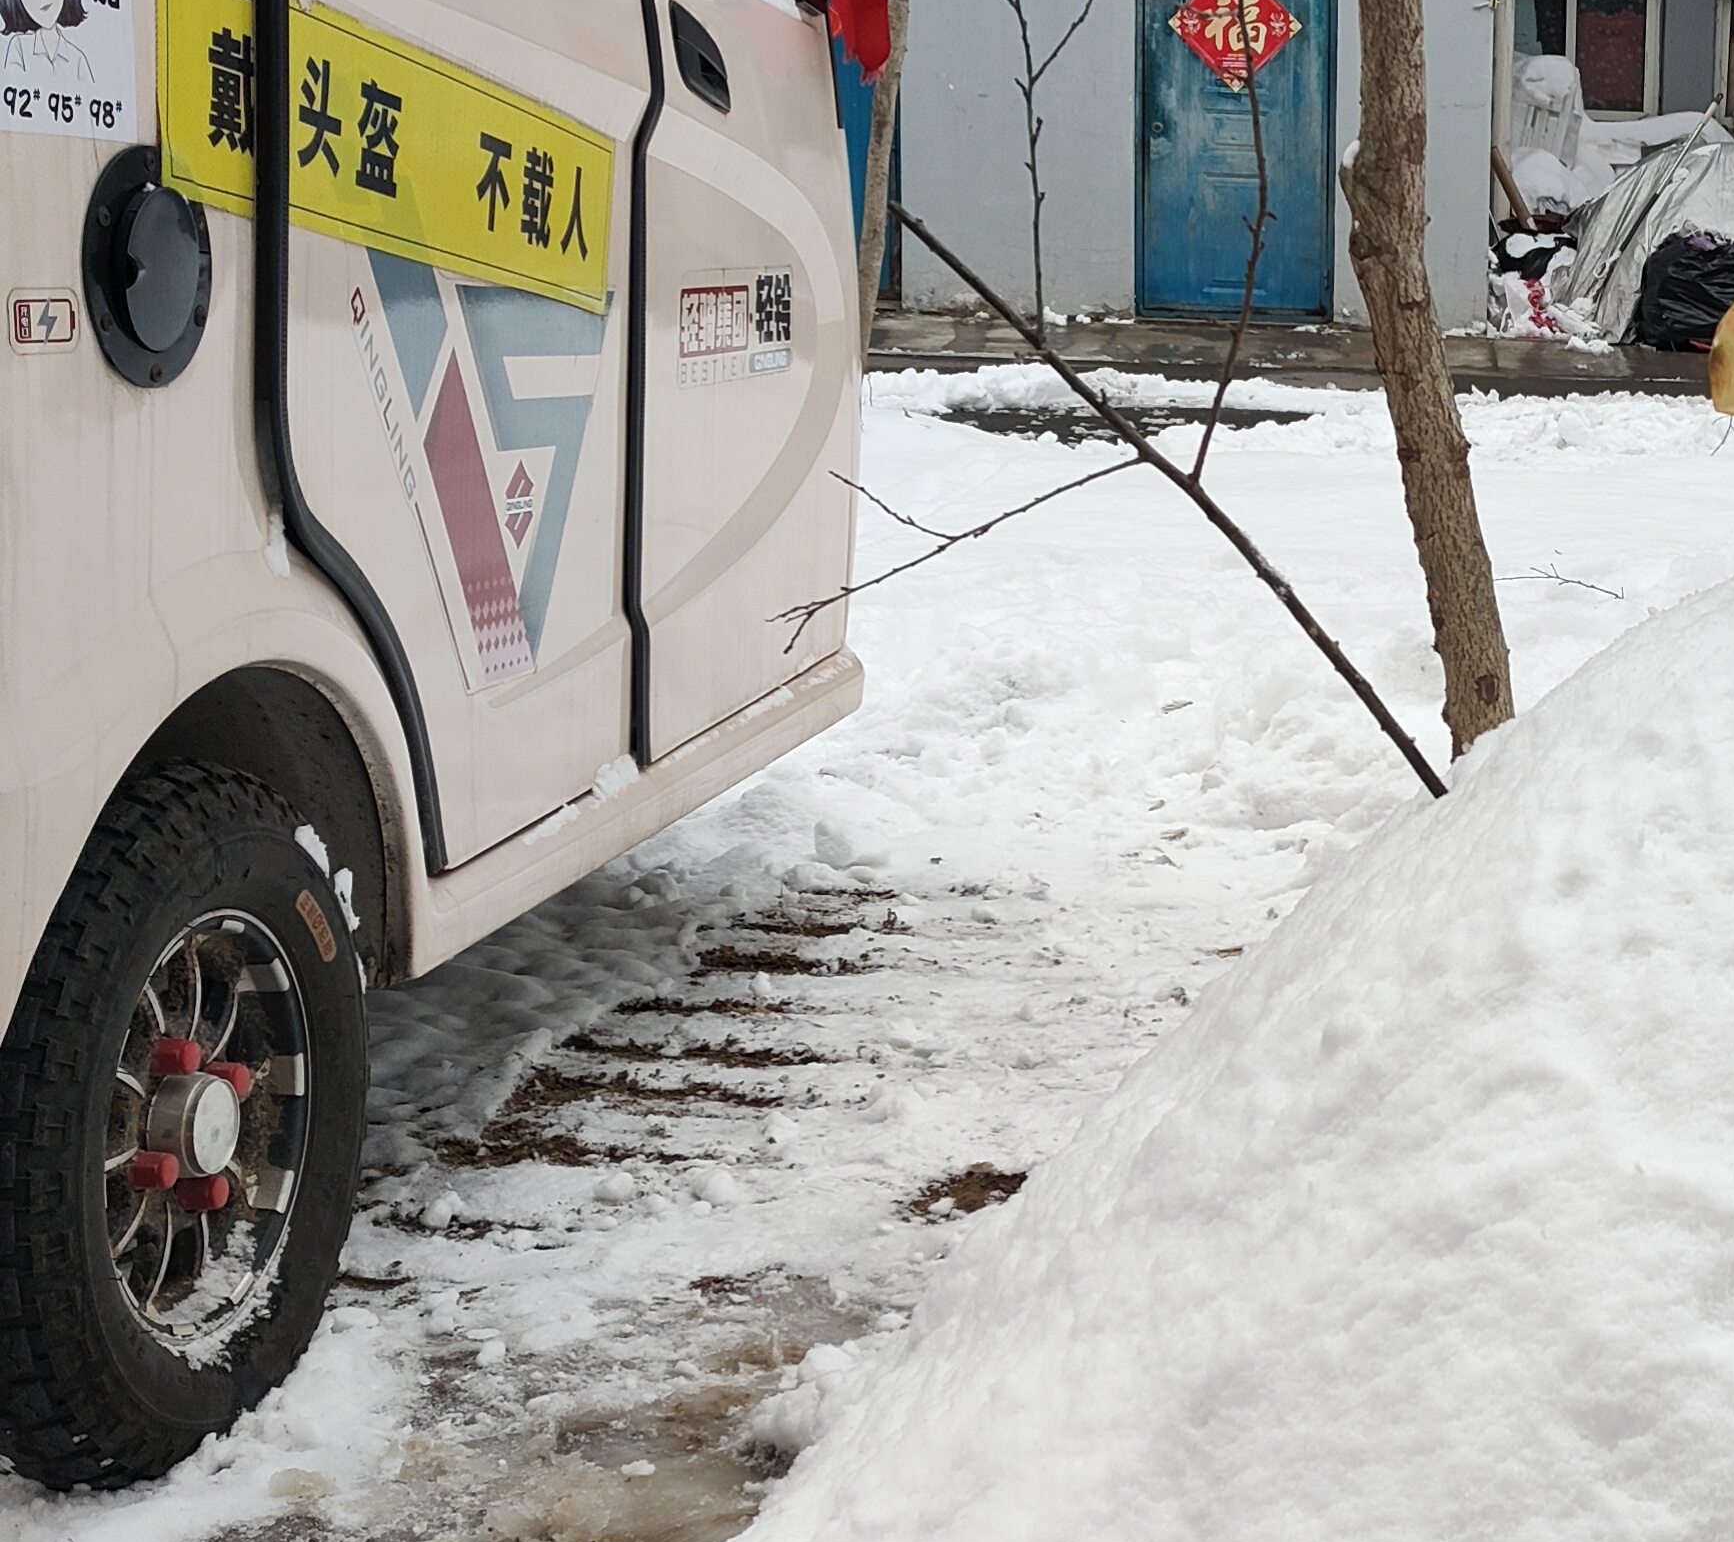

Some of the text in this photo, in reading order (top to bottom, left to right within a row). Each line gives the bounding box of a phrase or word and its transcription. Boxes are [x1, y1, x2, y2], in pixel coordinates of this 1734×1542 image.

[475, 131, 589, 262] 不载人
[350, 286, 417, 501] QINGLING
